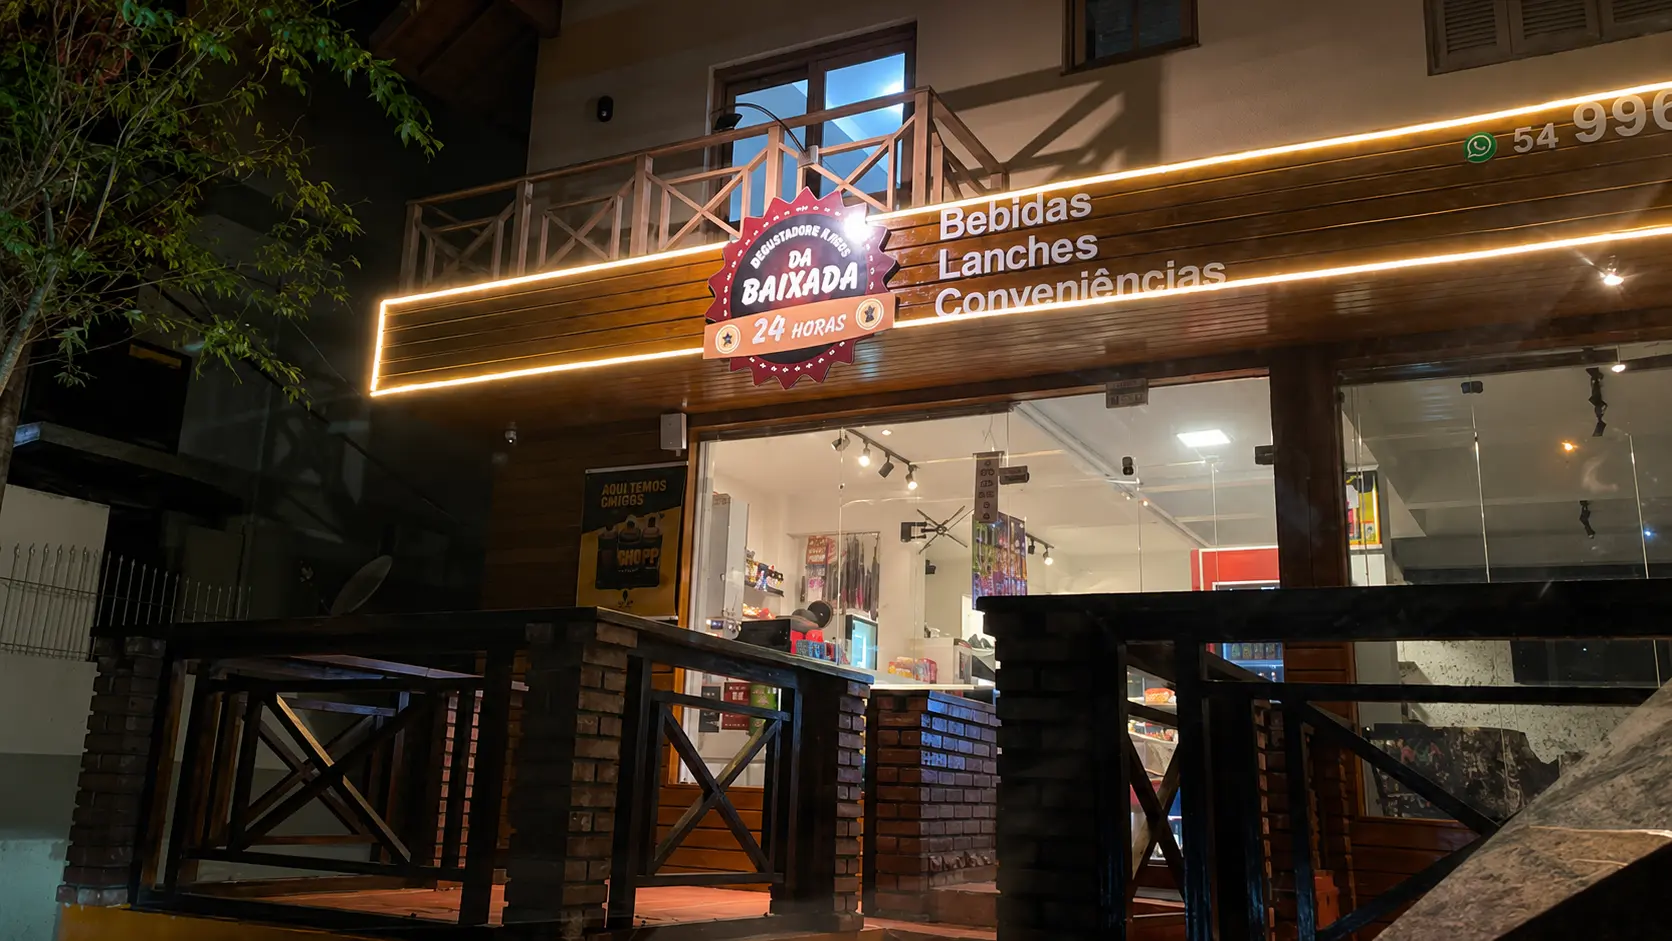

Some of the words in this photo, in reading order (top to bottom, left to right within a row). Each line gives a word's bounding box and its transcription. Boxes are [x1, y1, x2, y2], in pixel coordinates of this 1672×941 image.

[1514, 123, 1559, 153] 54
[1573, 89, 1672, 142] 996
[940, 193, 1092, 240] Bebidas
[788, 248, 811, 269] DA
[939, 235, 1098, 280] Lanches
[741, 262, 858, 306] BAIXADA
[935, 260, 1226, 317] Conveniências
[752, 315, 785, 345] 24
[791, 314, 847, 339] HORAS
[629, 479, 667, 494] TEMOS
[617, 547, 659, 567] CHOPP
